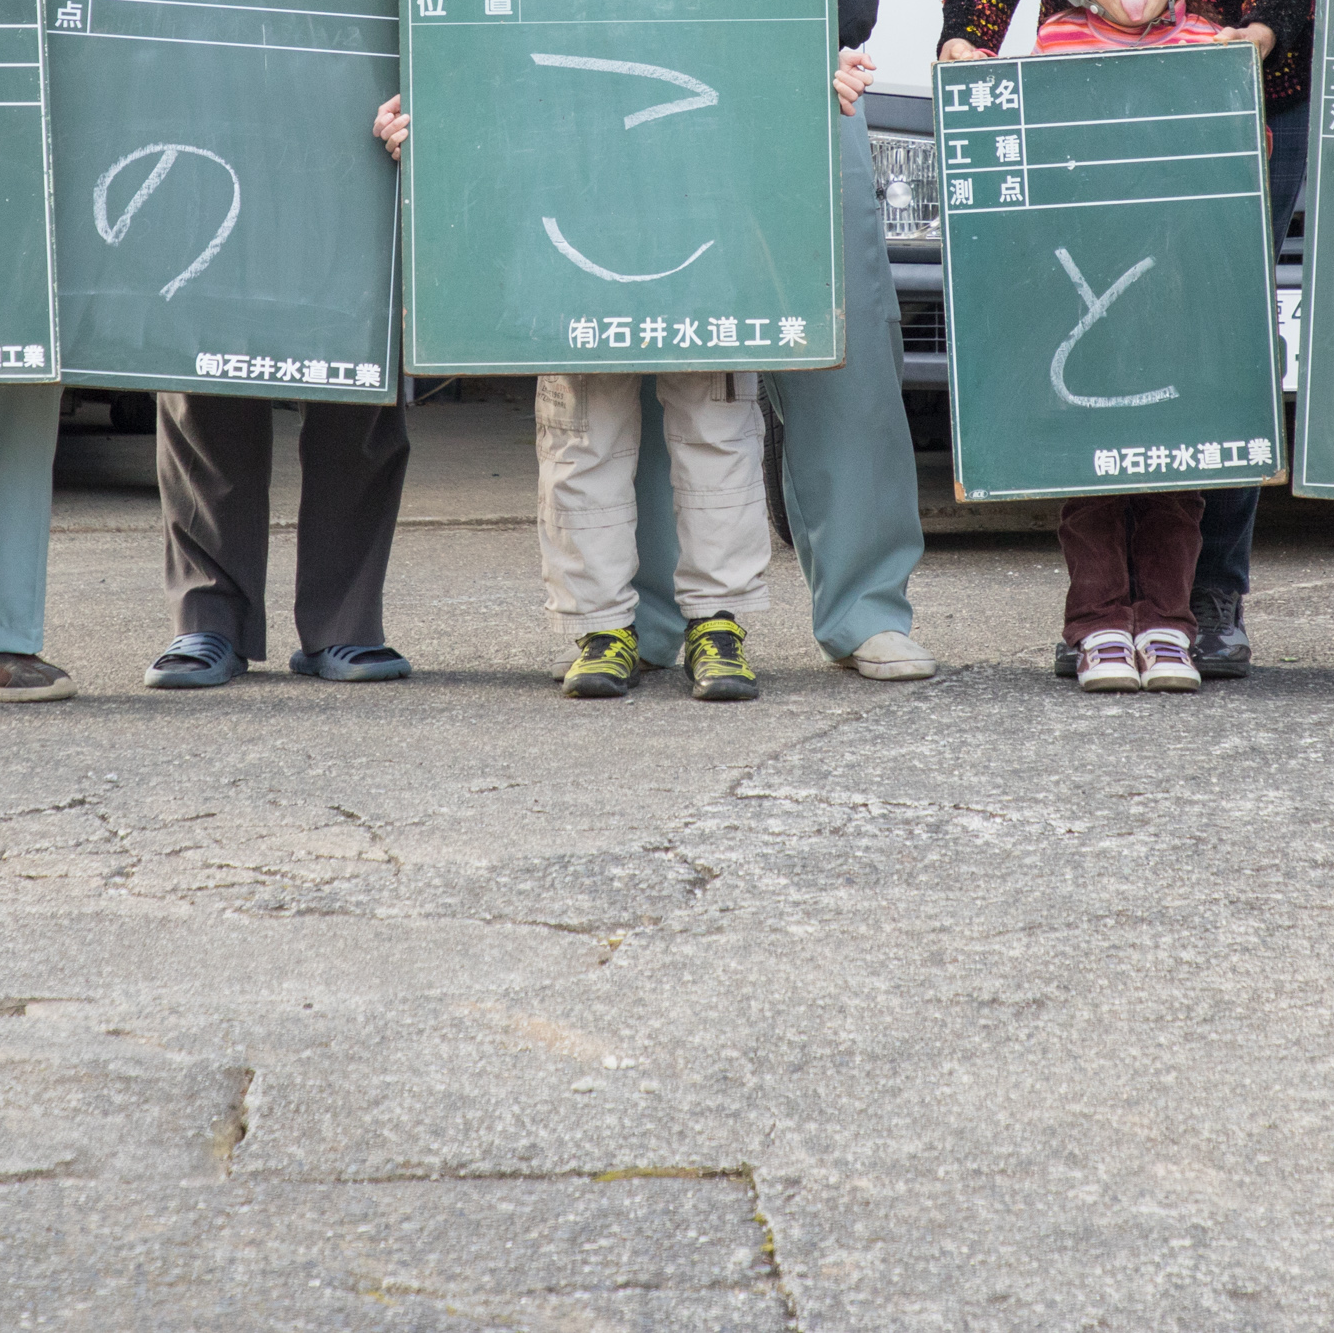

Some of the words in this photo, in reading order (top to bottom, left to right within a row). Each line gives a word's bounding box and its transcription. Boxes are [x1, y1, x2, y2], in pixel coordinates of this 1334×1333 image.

[530, 53, 719, 283] こ
[944, 79, 1019, 113] 工事名
[92, 142, 241, 301] の
[1050, 247, 1180, 408] と
